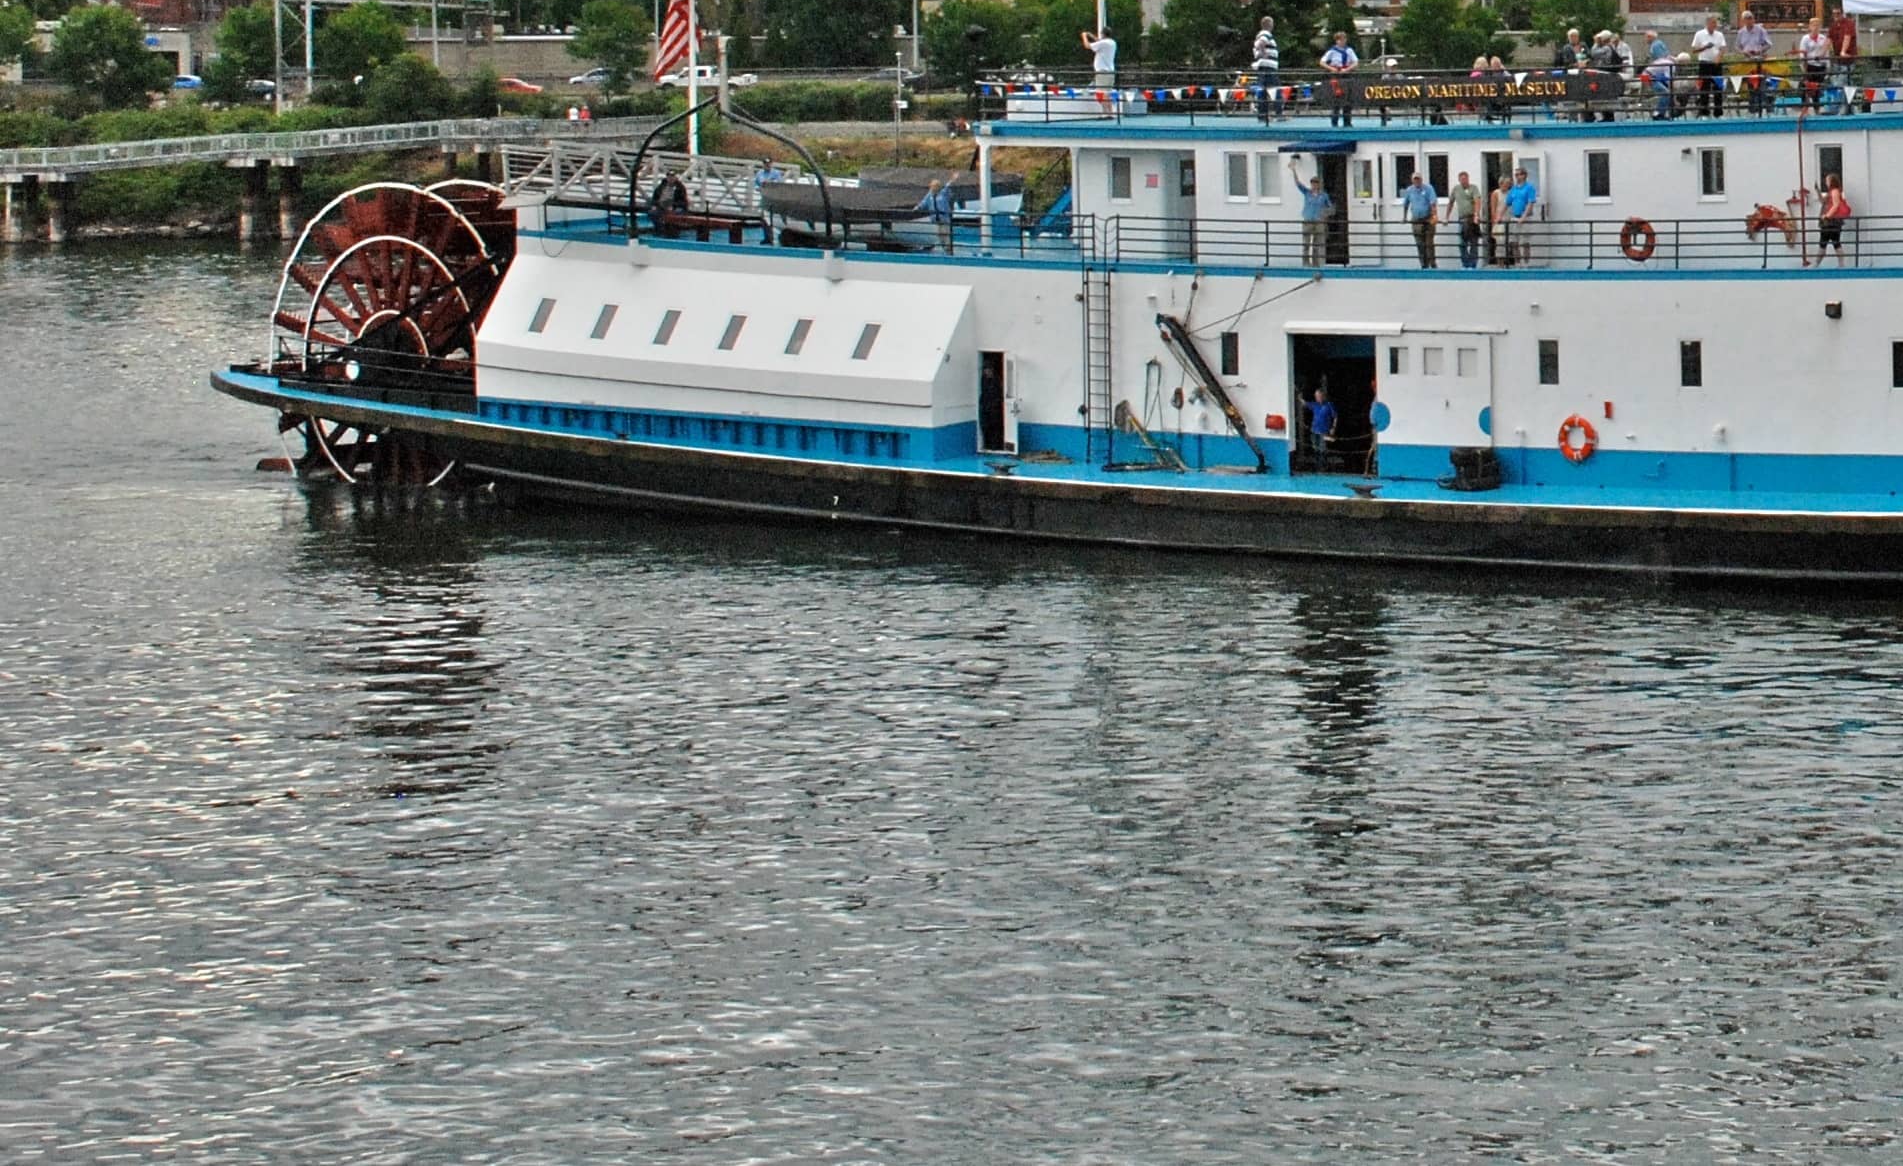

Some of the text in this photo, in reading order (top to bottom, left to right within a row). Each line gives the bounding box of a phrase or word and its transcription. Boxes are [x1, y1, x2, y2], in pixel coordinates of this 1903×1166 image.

[1364, 81, 1567, 100] OREGON MARITIME MUSEUM
